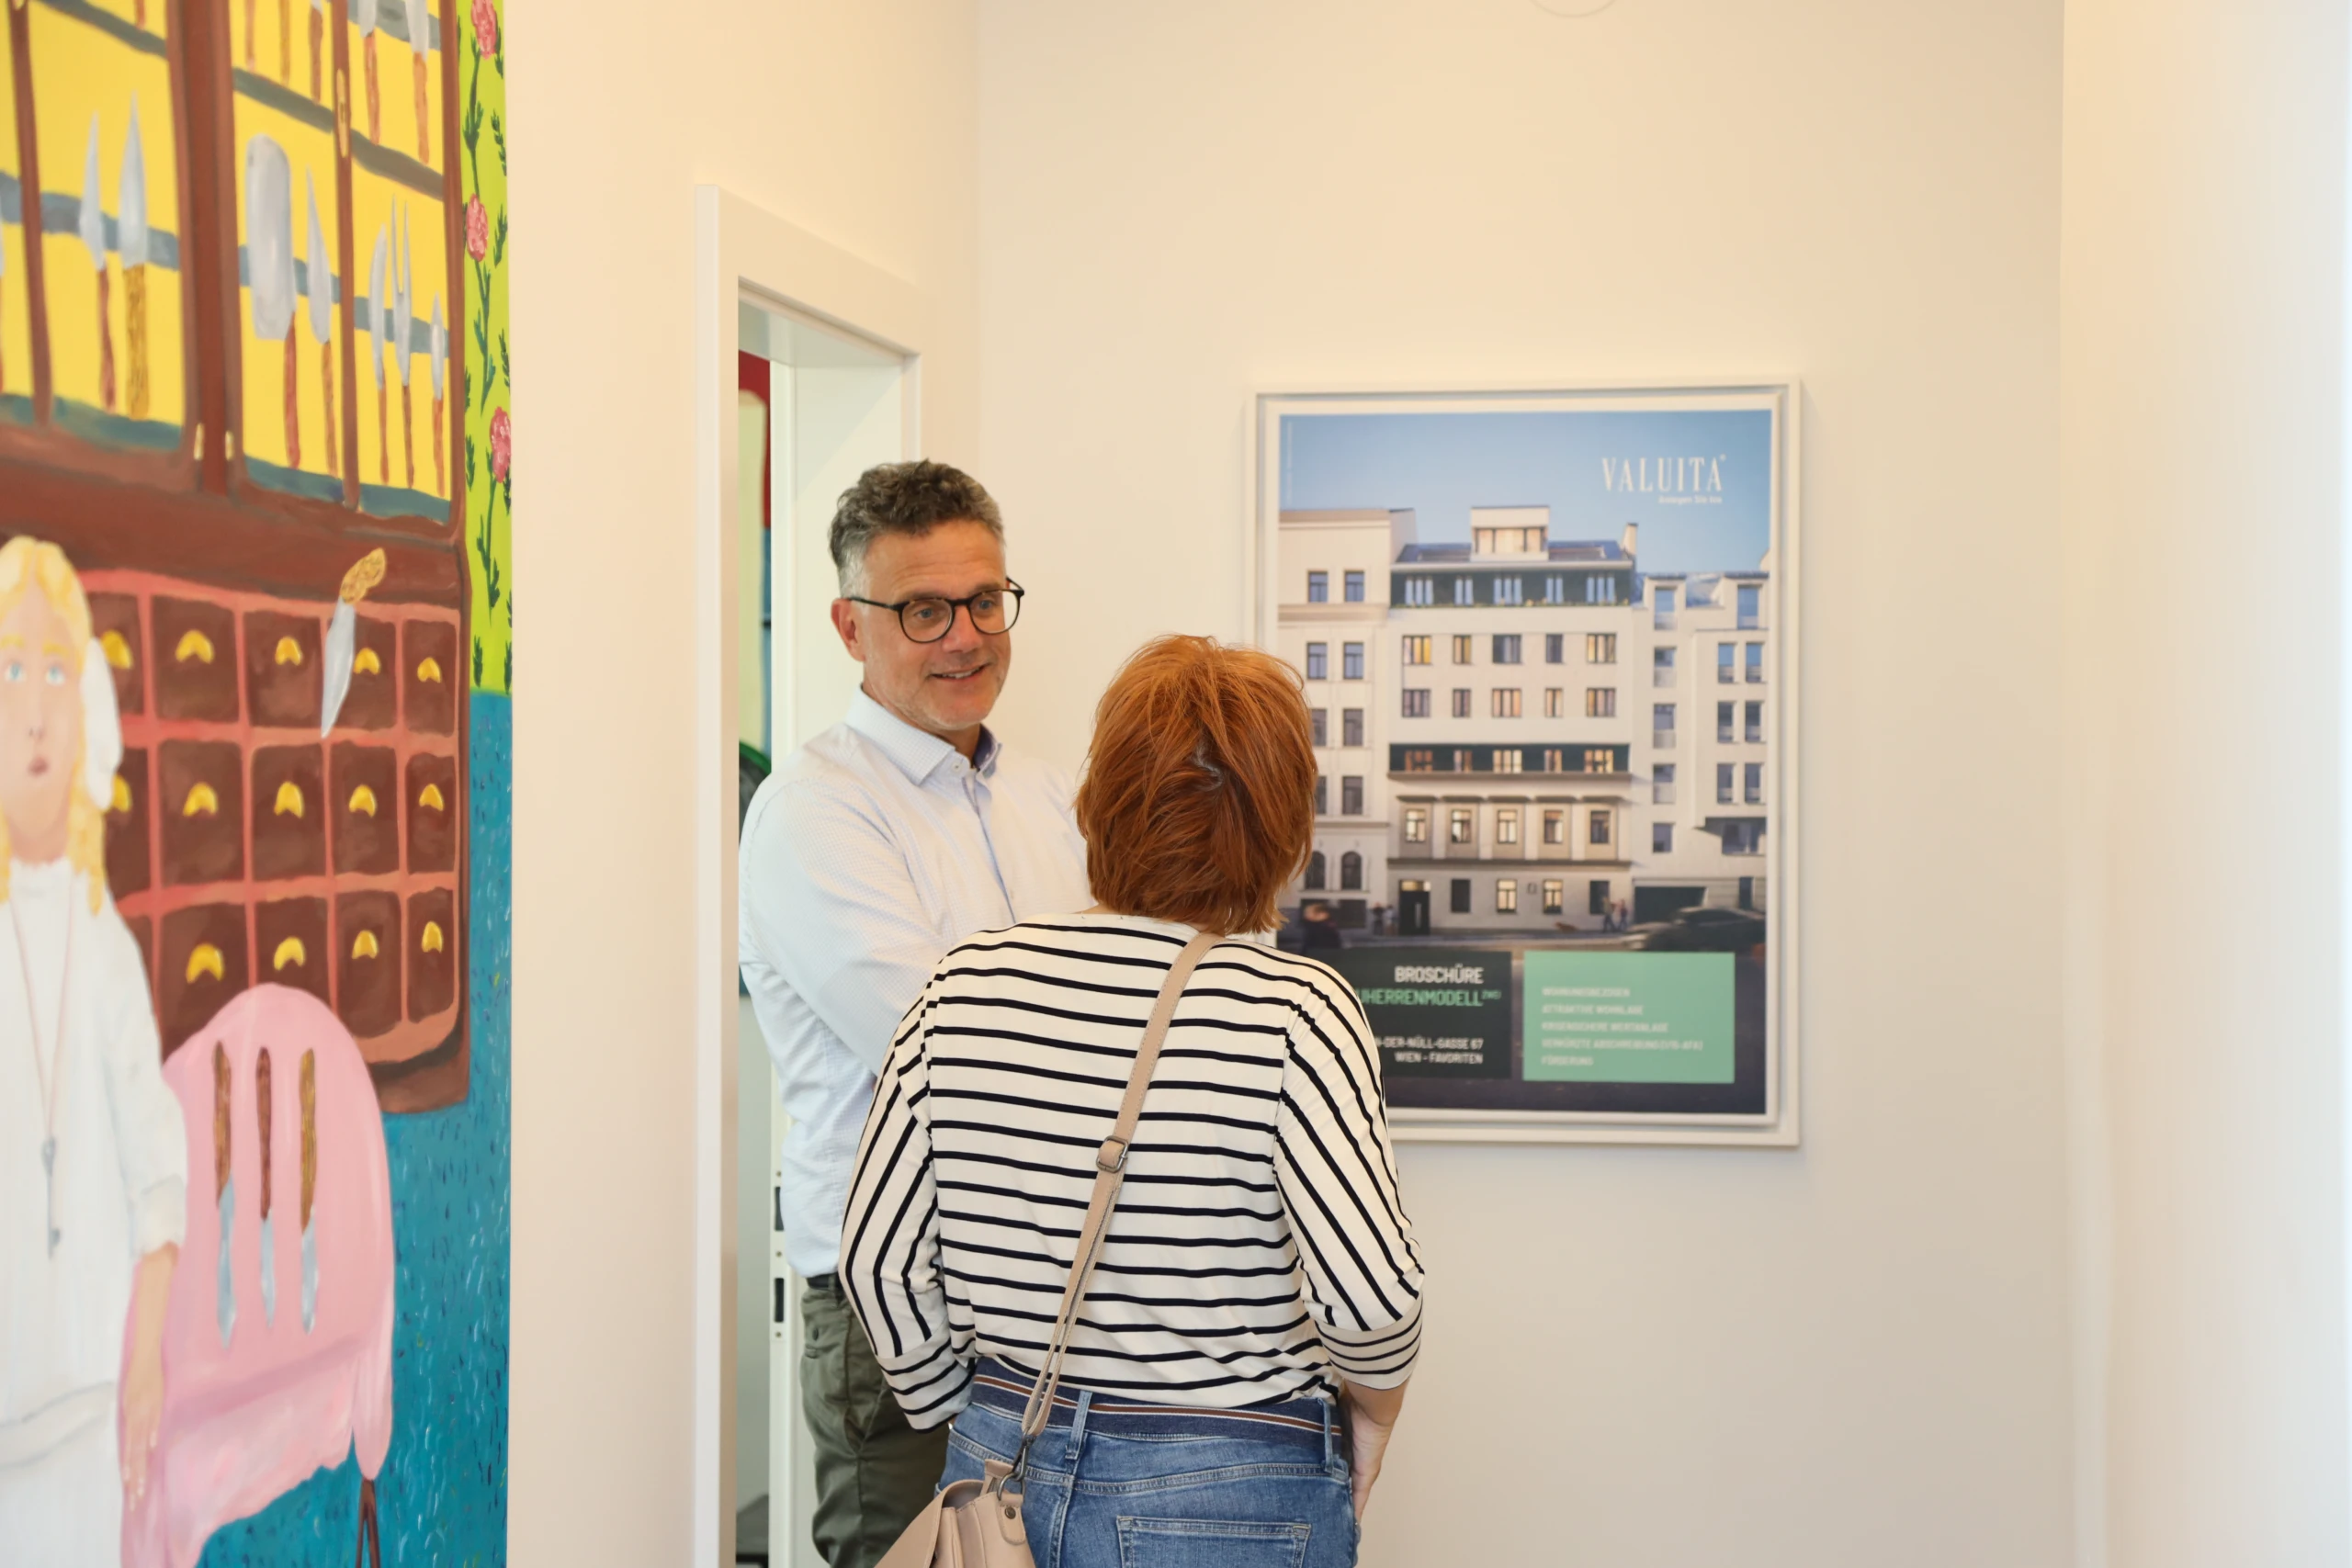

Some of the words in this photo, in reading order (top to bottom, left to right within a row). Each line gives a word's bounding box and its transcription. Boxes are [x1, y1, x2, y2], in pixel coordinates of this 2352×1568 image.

[1601, 457, 1723, 492] VALUITA
[1394, 963, 1485, 984] BROSCHÜRE
[1355, 988, 1483, 1006] UHERRENMODELL
[1374, 1034, 1469, 1049] N-DER-NÜLL-GASSE
[1394, 1051, 1421, 1063] WIEN
[1429, 1052, 1484, 1064] FAVORITEN
